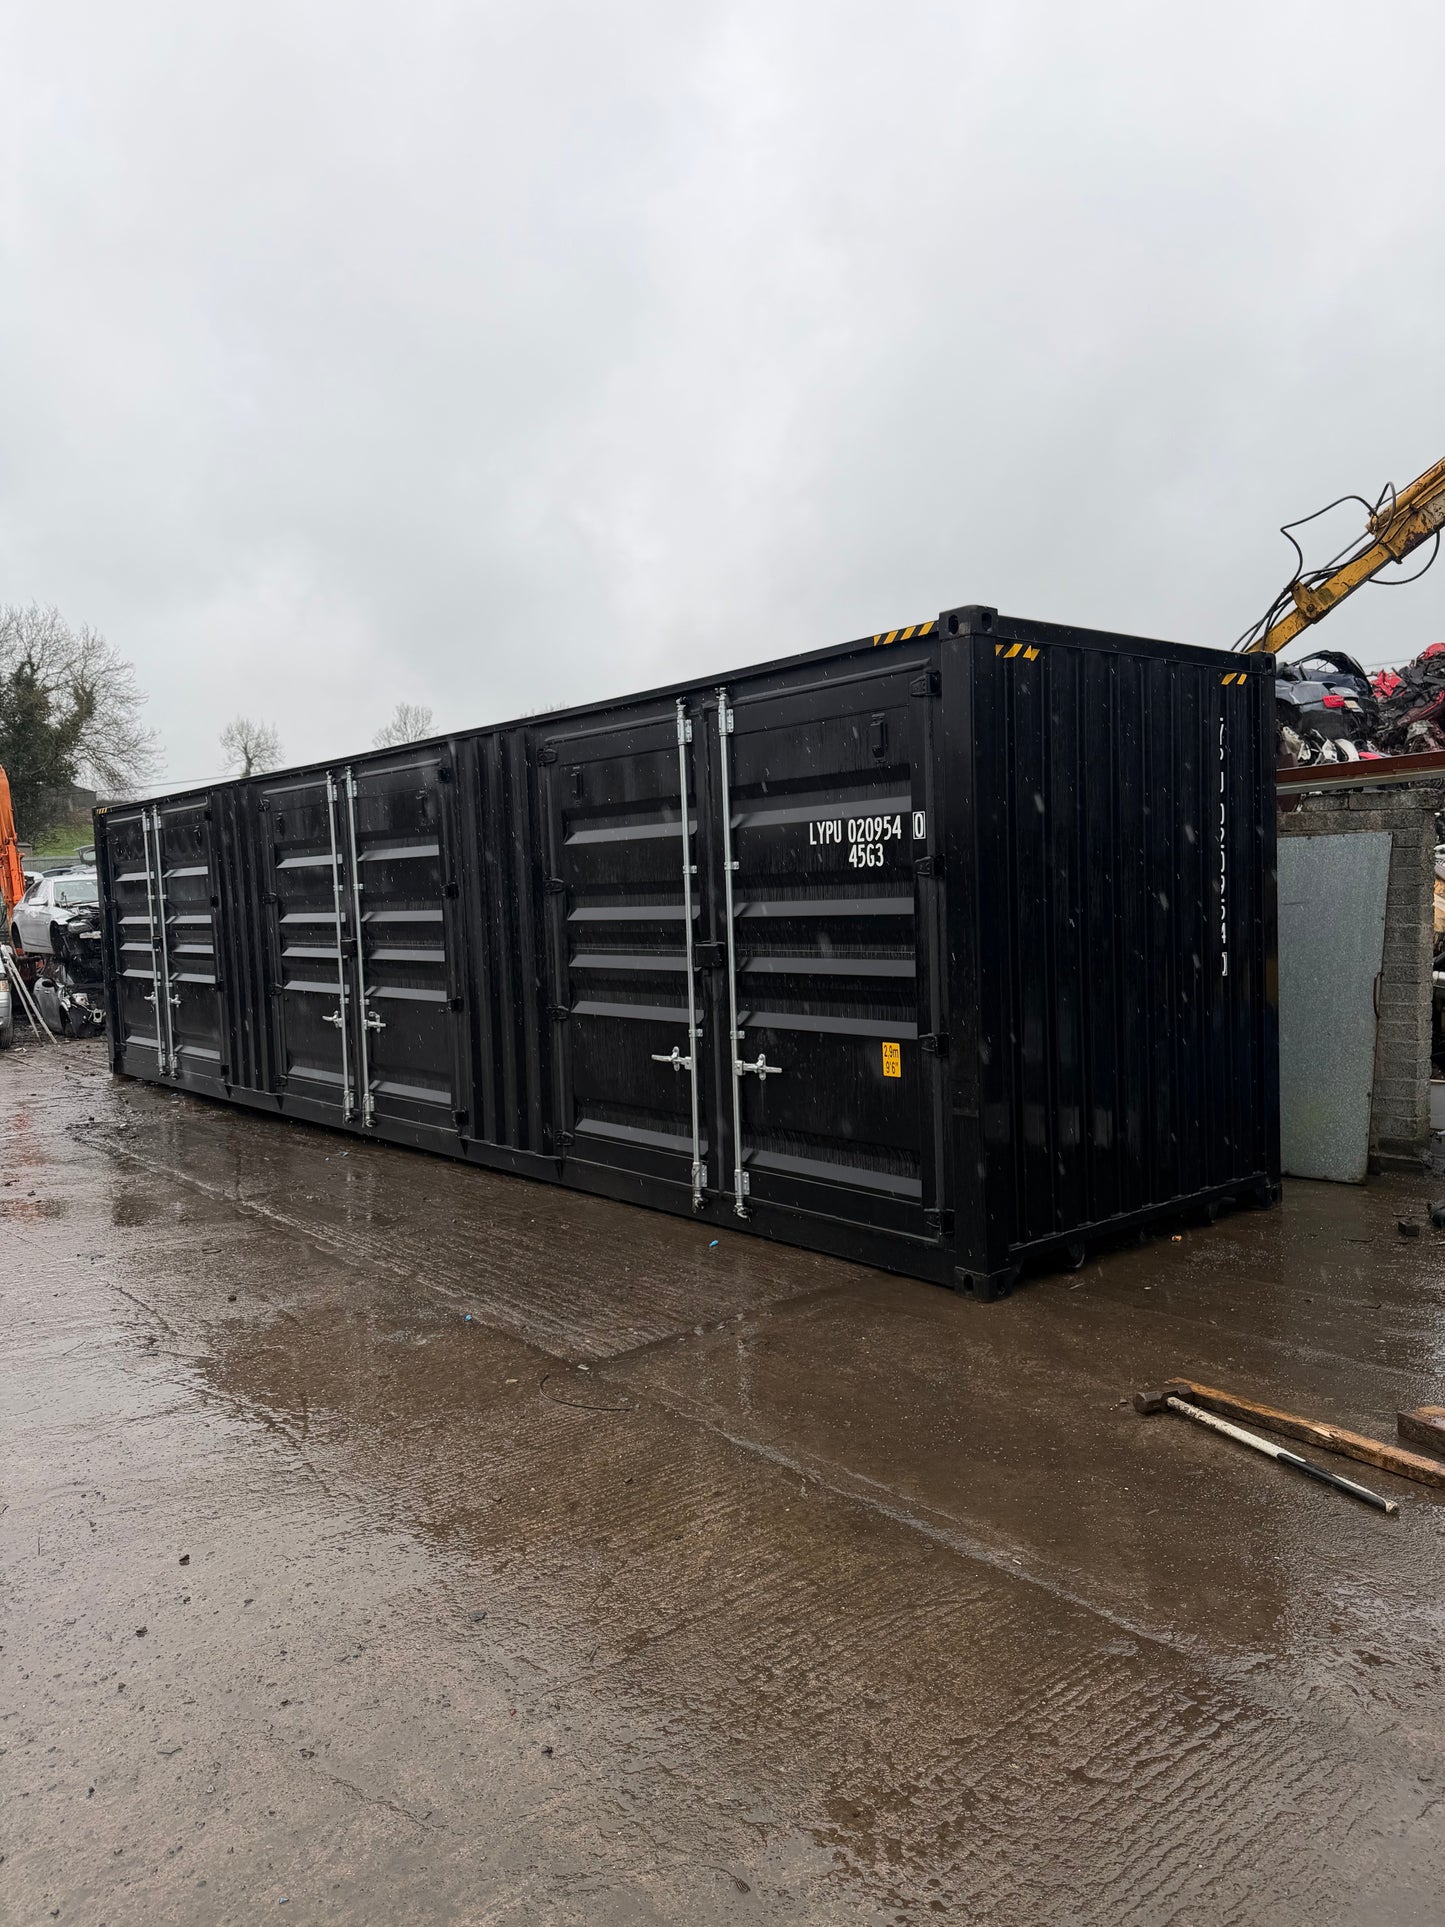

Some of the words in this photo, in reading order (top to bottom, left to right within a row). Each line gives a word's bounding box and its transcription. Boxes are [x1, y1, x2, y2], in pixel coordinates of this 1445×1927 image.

[810, 820, 842, 845] LYPU
[848, 815, 901, 843] 020954
[914, 812, 925, 838] 0
[849, 843, 884, 868] 45G3
